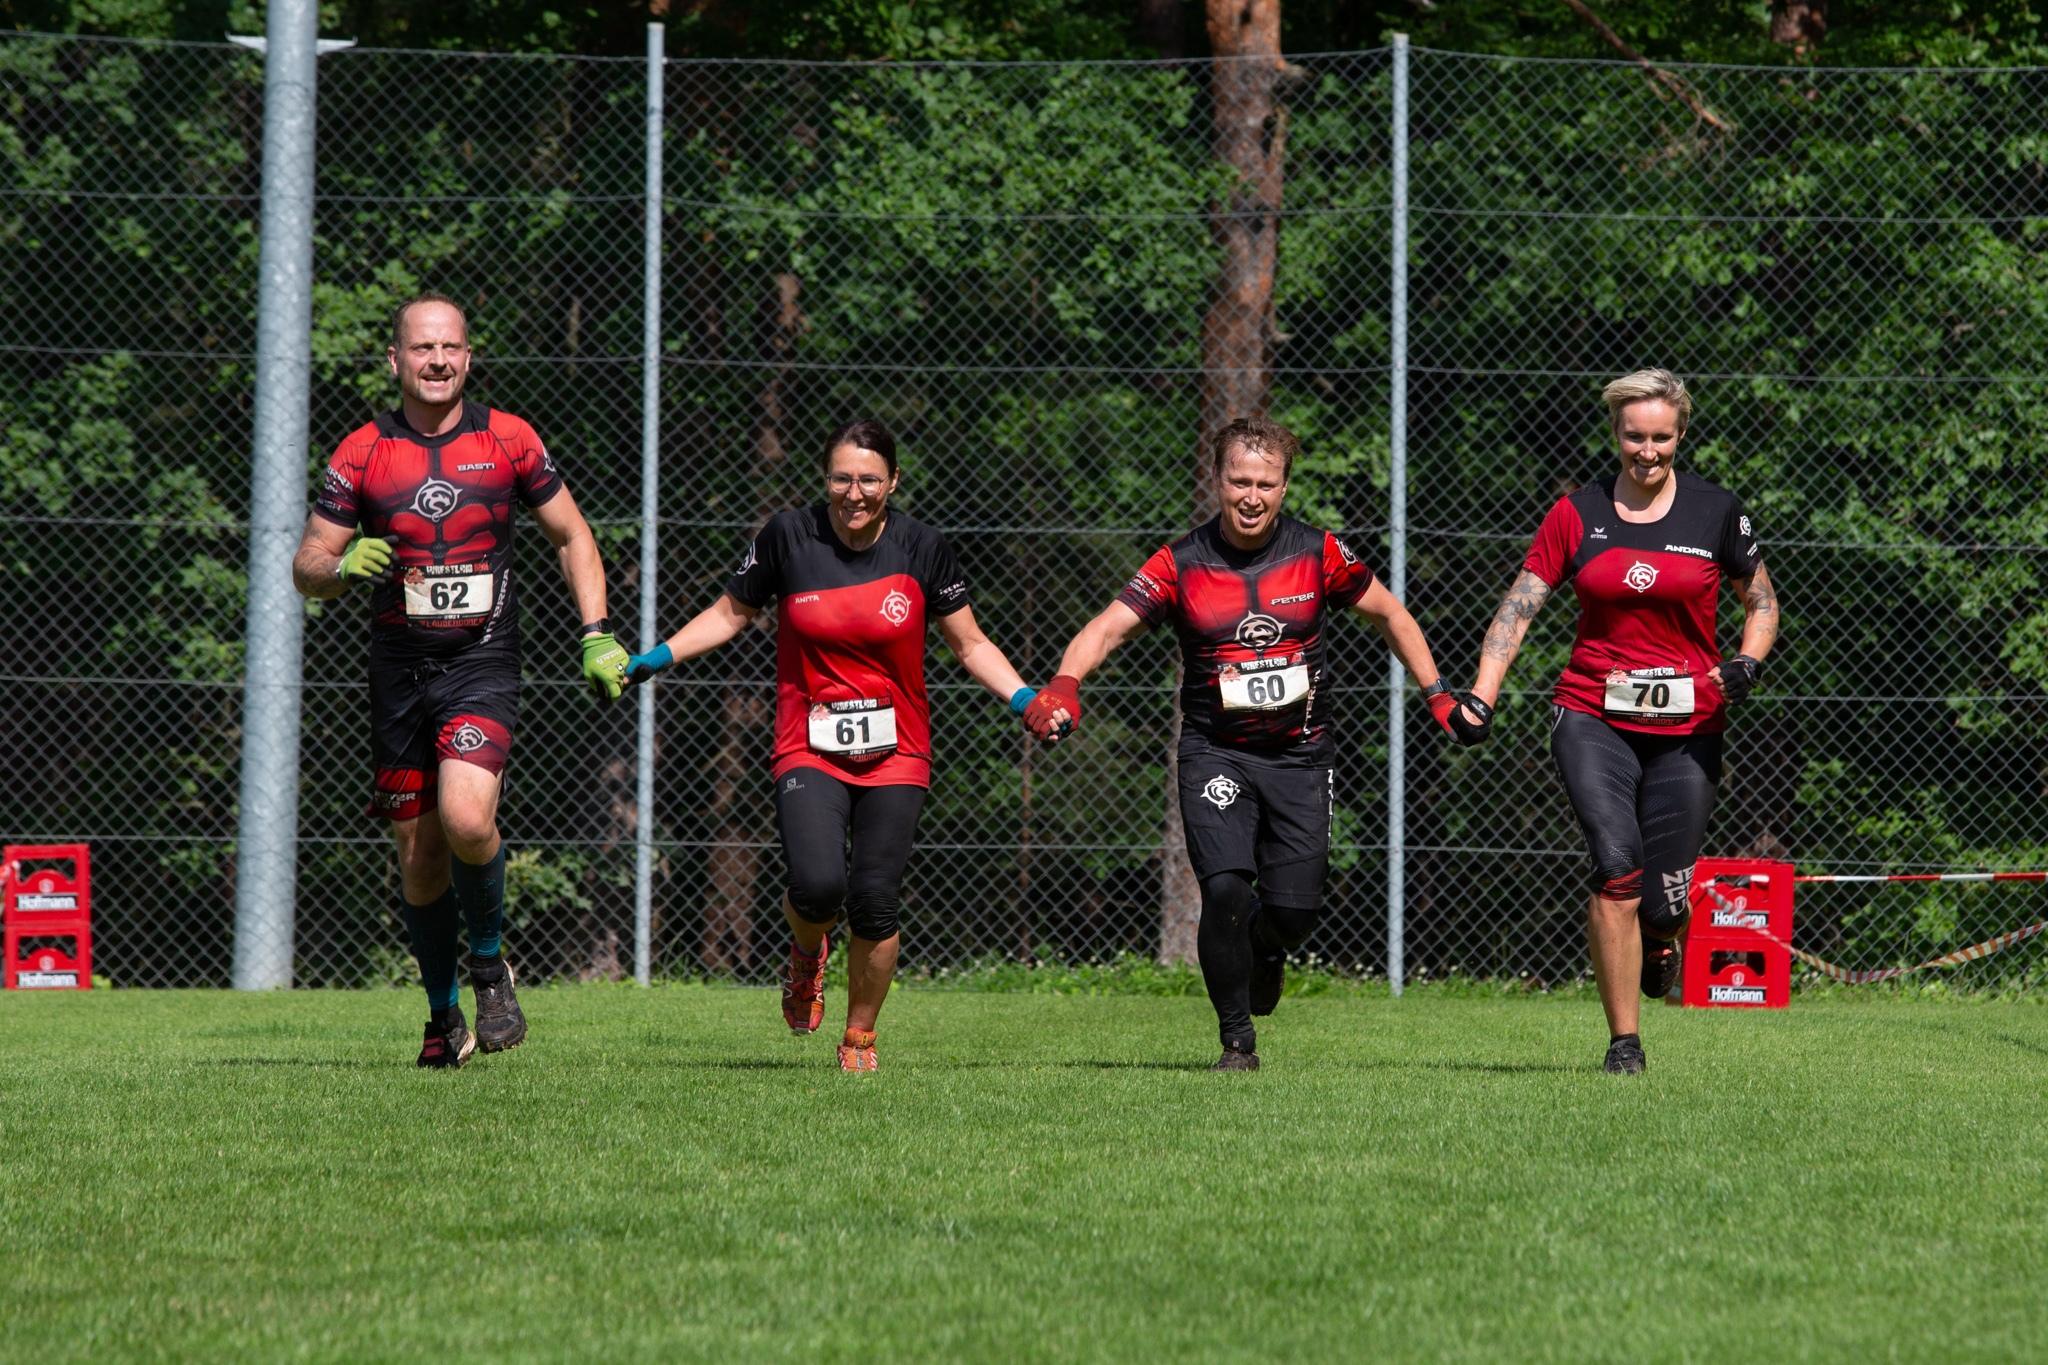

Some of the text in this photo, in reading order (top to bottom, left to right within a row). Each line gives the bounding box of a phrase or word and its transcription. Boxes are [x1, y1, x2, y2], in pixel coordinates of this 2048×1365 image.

[1664, 544, 1712, 560] ANDREA
[430, 581, 469, 611] 62
[1271, 591, 1315, 605] PETER
[1247, 674, 1285, 705] 60
[1632, 682, 1670, 709] 70
[836, 716, 870, 745] 61
[1711, 986, 1764, 1001] Hofmann
